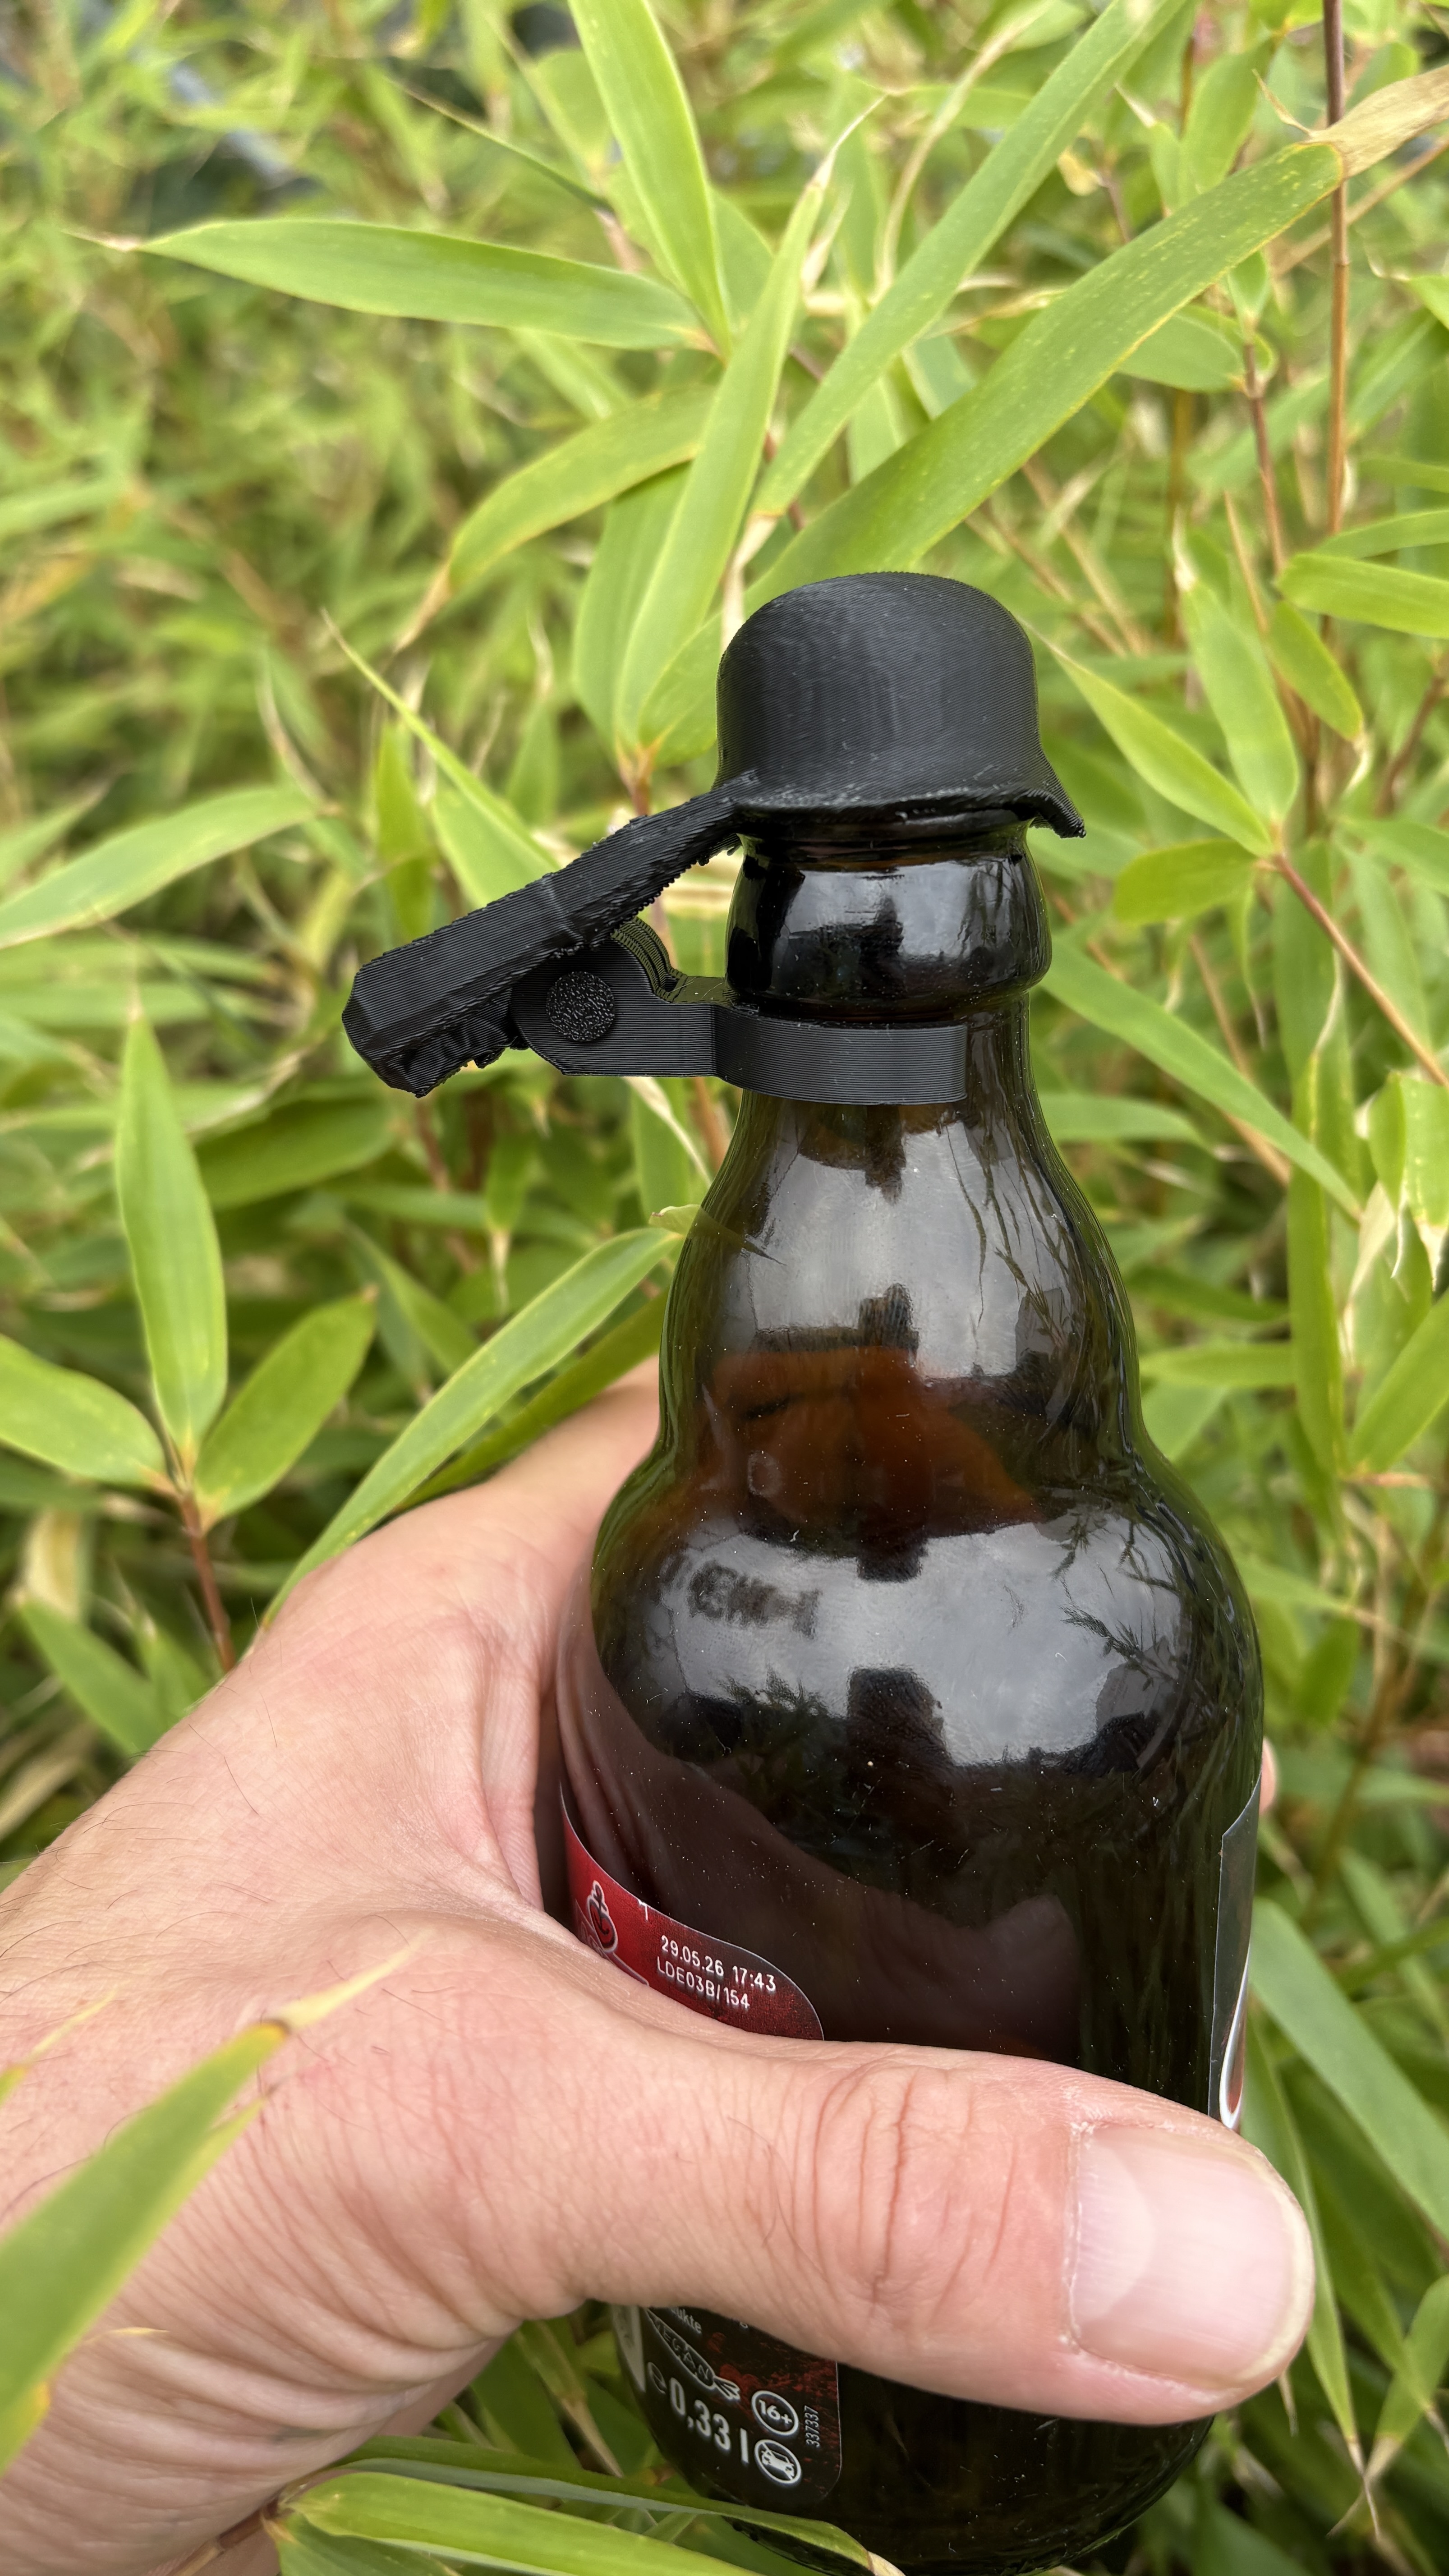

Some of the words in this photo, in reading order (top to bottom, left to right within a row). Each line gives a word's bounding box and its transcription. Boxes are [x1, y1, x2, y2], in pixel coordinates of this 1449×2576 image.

[661, 1935, 724, 1976] 29.05.26
[732, 1965, 776, 1992] 17:43
[670, 2377, 731, 2450] 0,33
[759, 2399, 793, 2424] 16+
[804, 2405, 820, 2447] 337337
